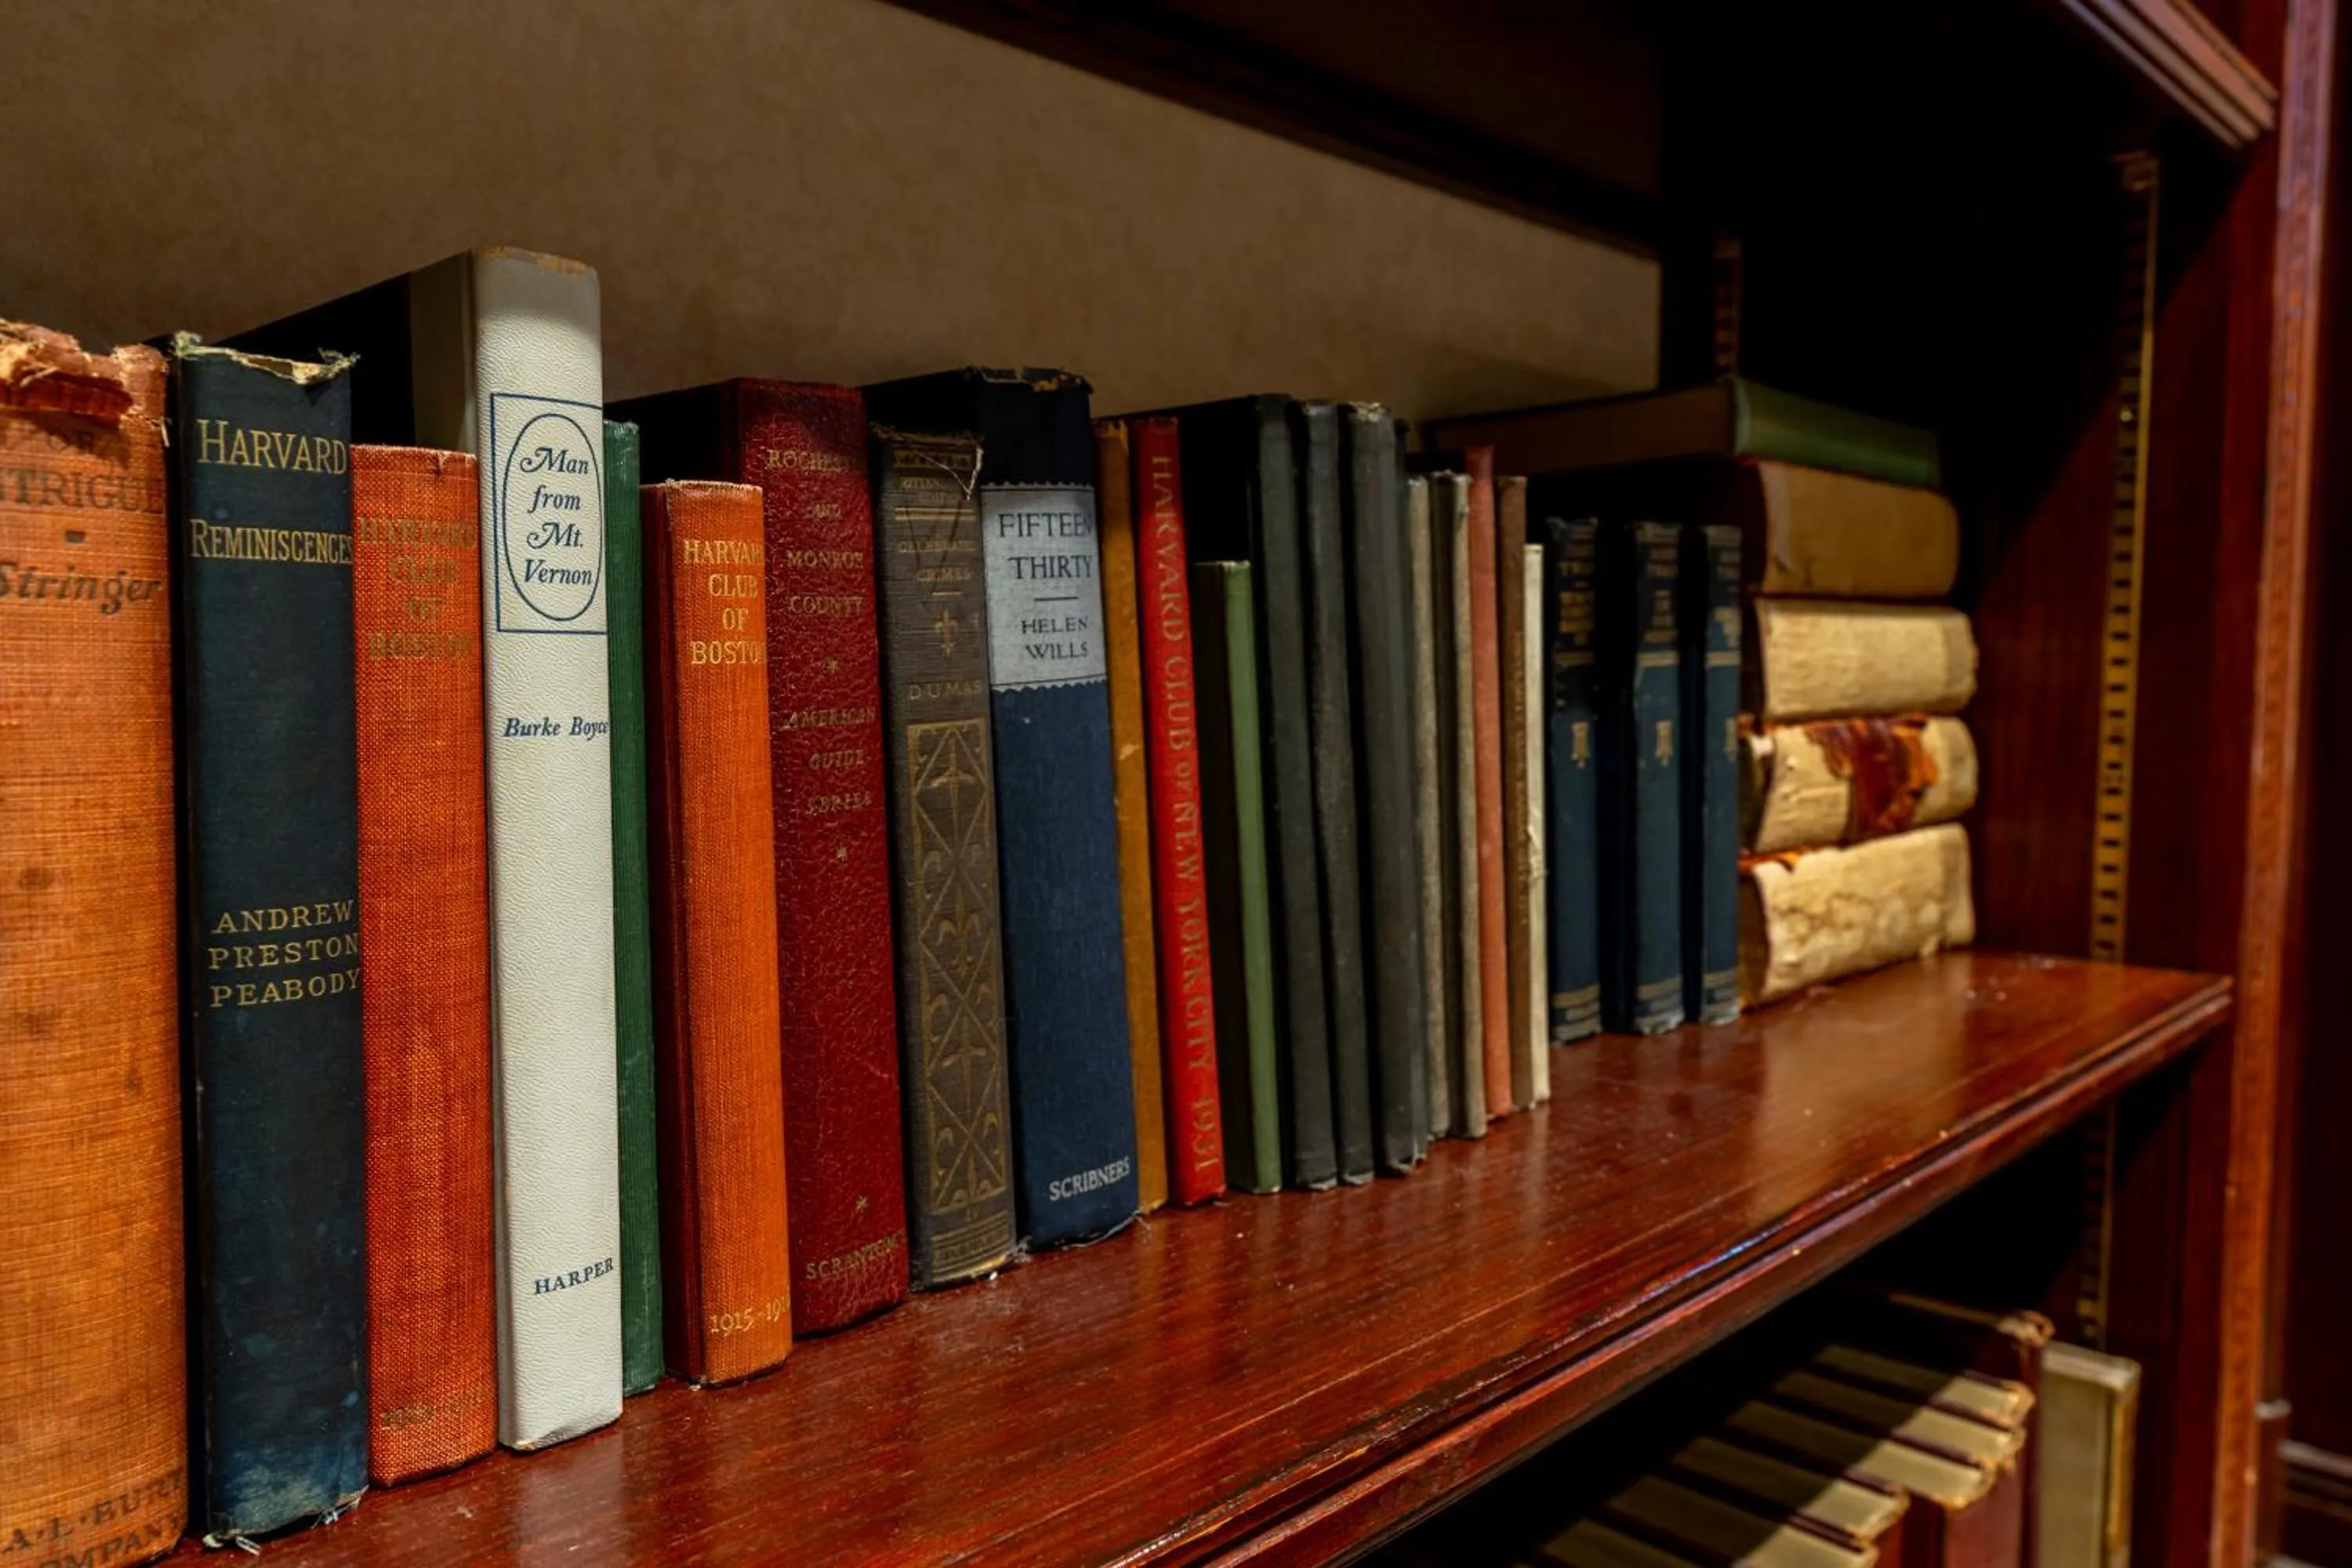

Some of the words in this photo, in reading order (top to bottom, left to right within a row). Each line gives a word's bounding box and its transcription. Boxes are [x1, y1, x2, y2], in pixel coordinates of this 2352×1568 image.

[196, 419, 347, 474] HARVARD
[521, 447, 587, 474] Man
[528, 485, 581, 514] from
[527, 522, 583, 549] Mt.
[997, 513, 1092, 537] FIFTEEN
[1151, 455, 1185, 642] HARVARD
[524, 559, 592, 585] Vernon
[1008, 554, 1092, 579] THIRTY
[722, 608, 749, 631] OF
[1022, 616, 1088, 634] HELEN
[1025, 641, 1089, 660] WILLS
[1164, 655, 1193, 751] CLUB
[503, 717, 561, 737] Burke
[211, 899, 353, 934] ANDREW
[208, 933, 358, 970] PRESTON
[209, 968, 360, 1007] PEABODY
[1049, 1156, 1131, 1201] SCRIBNERS
[535, 1258, 614, 1295] HARPER
